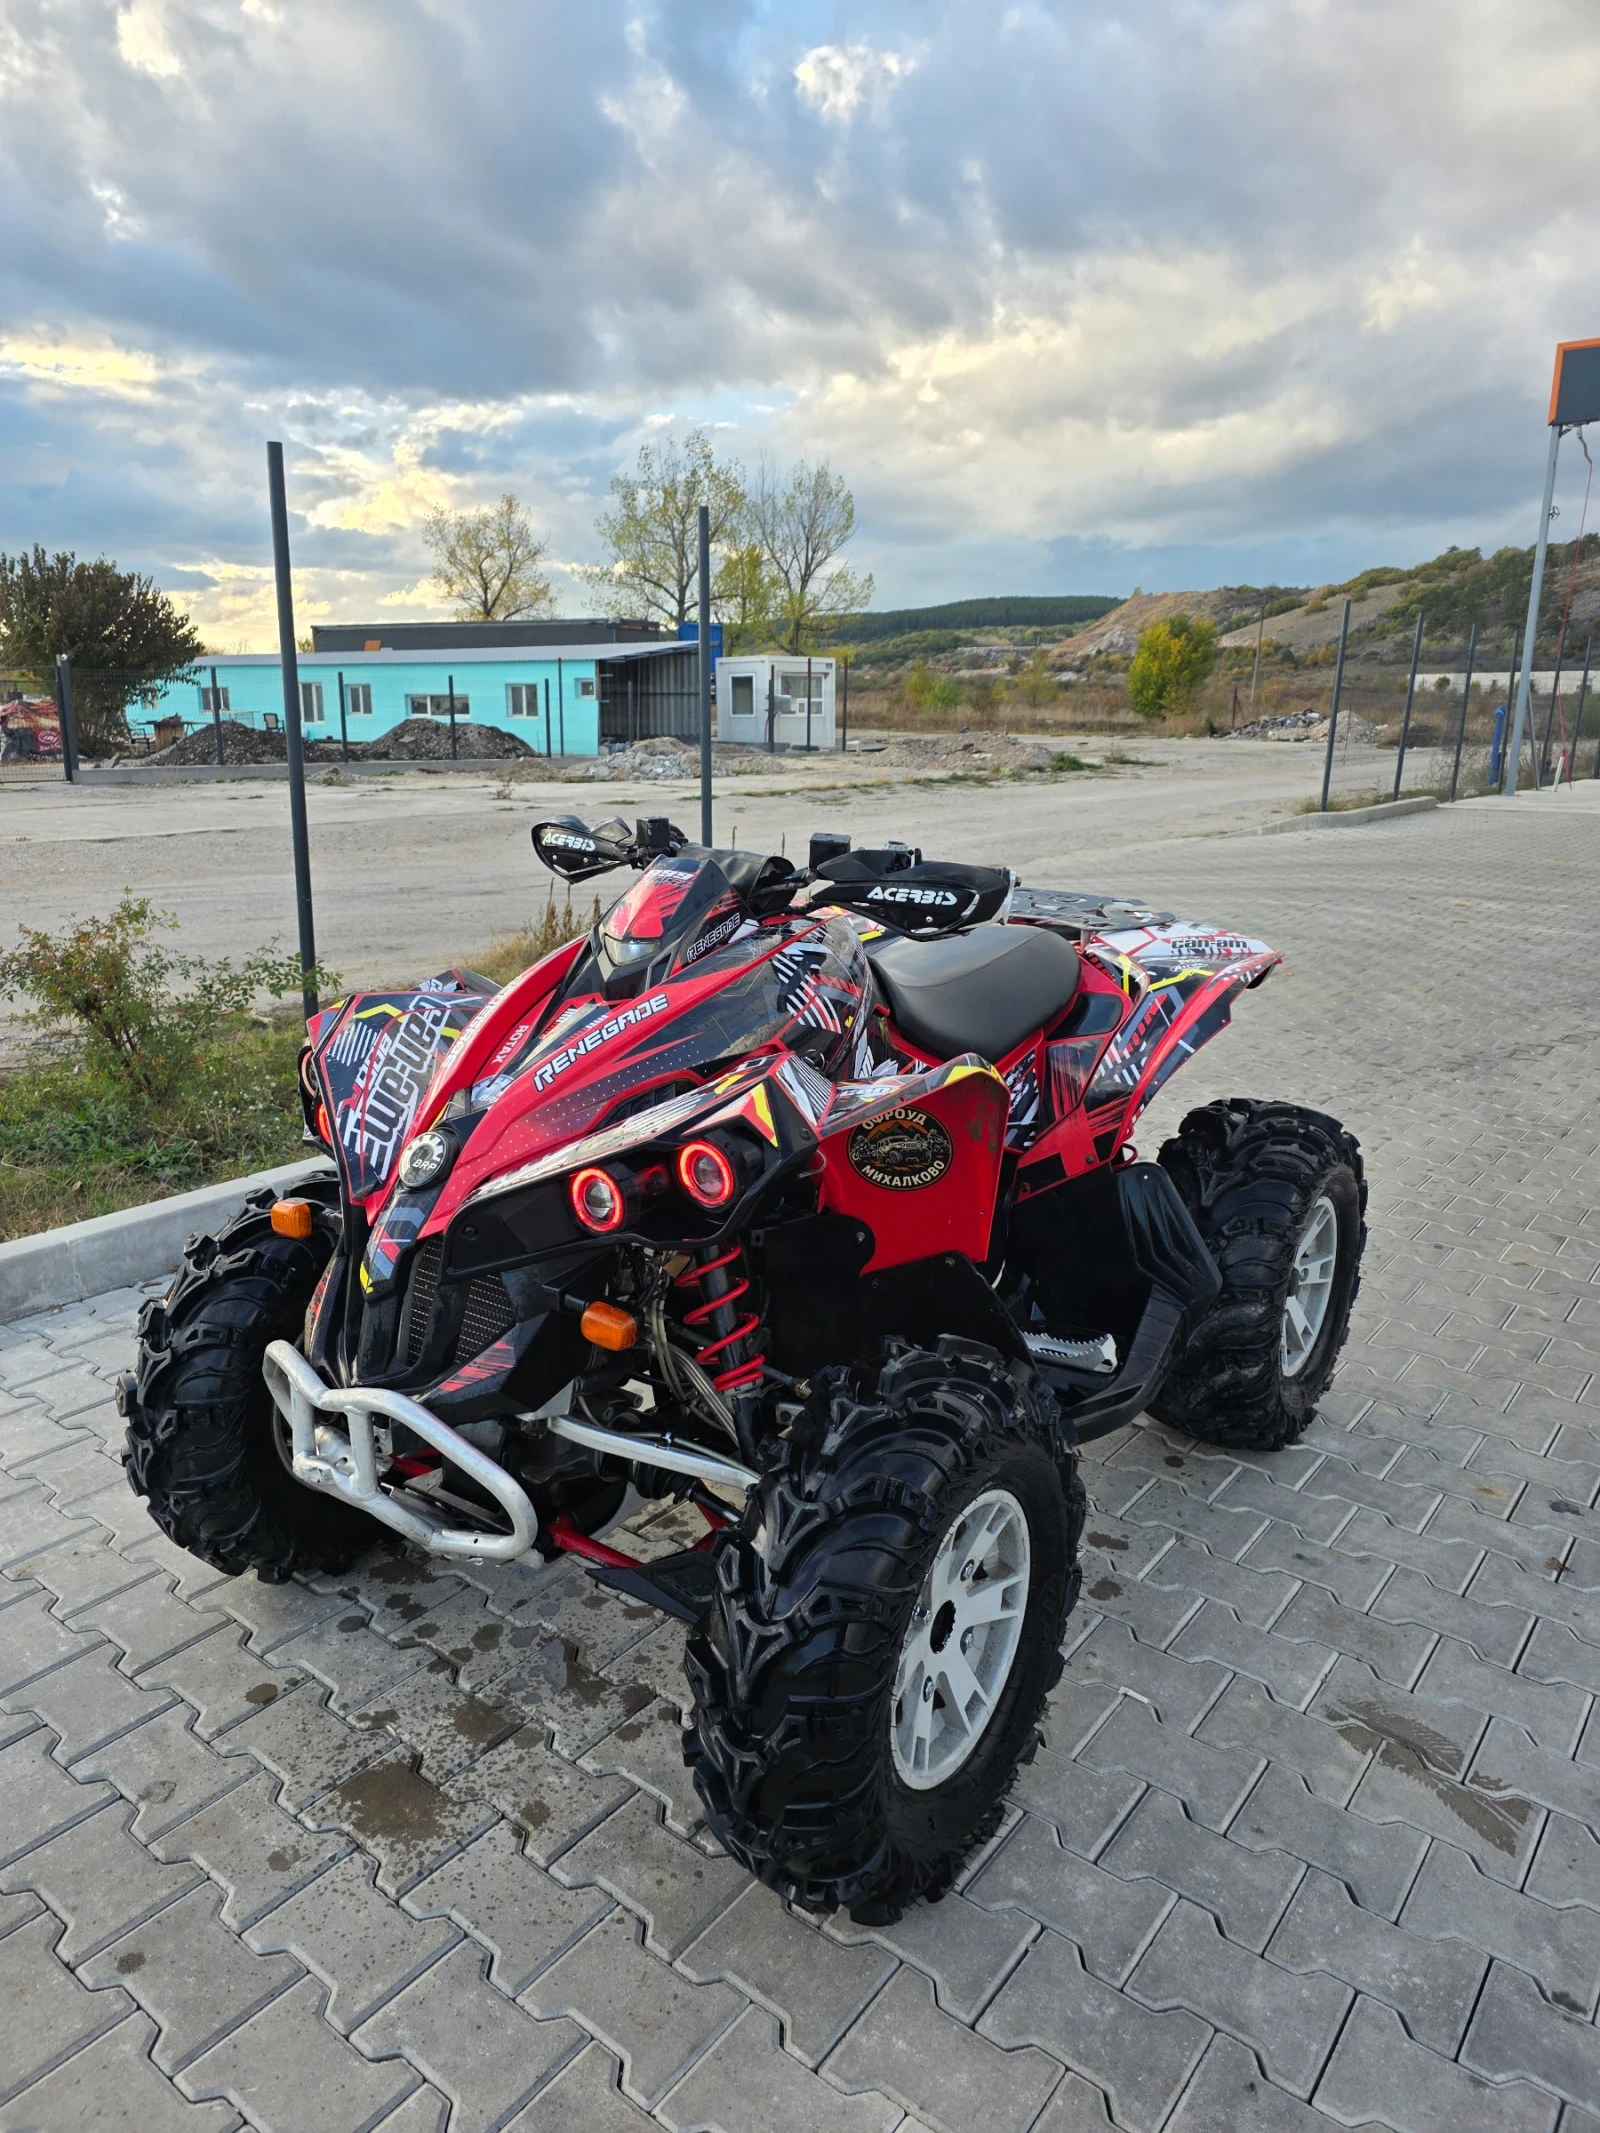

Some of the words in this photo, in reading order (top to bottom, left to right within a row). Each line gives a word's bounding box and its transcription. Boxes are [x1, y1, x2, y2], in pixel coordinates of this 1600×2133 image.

[1171, 939, 1247, 949] can-am
[491, 1025, 530, 1065] ROTAX
[533, 993, 669, 1092] RENEGADE
[479, 1094, 497, 1103] BR
[862, 1108, 927, 1130] ОФРОУД
[412, 1159, 437, 1171] BRP
[861, 1160, 945, 1187] МИХАЛКОВО
